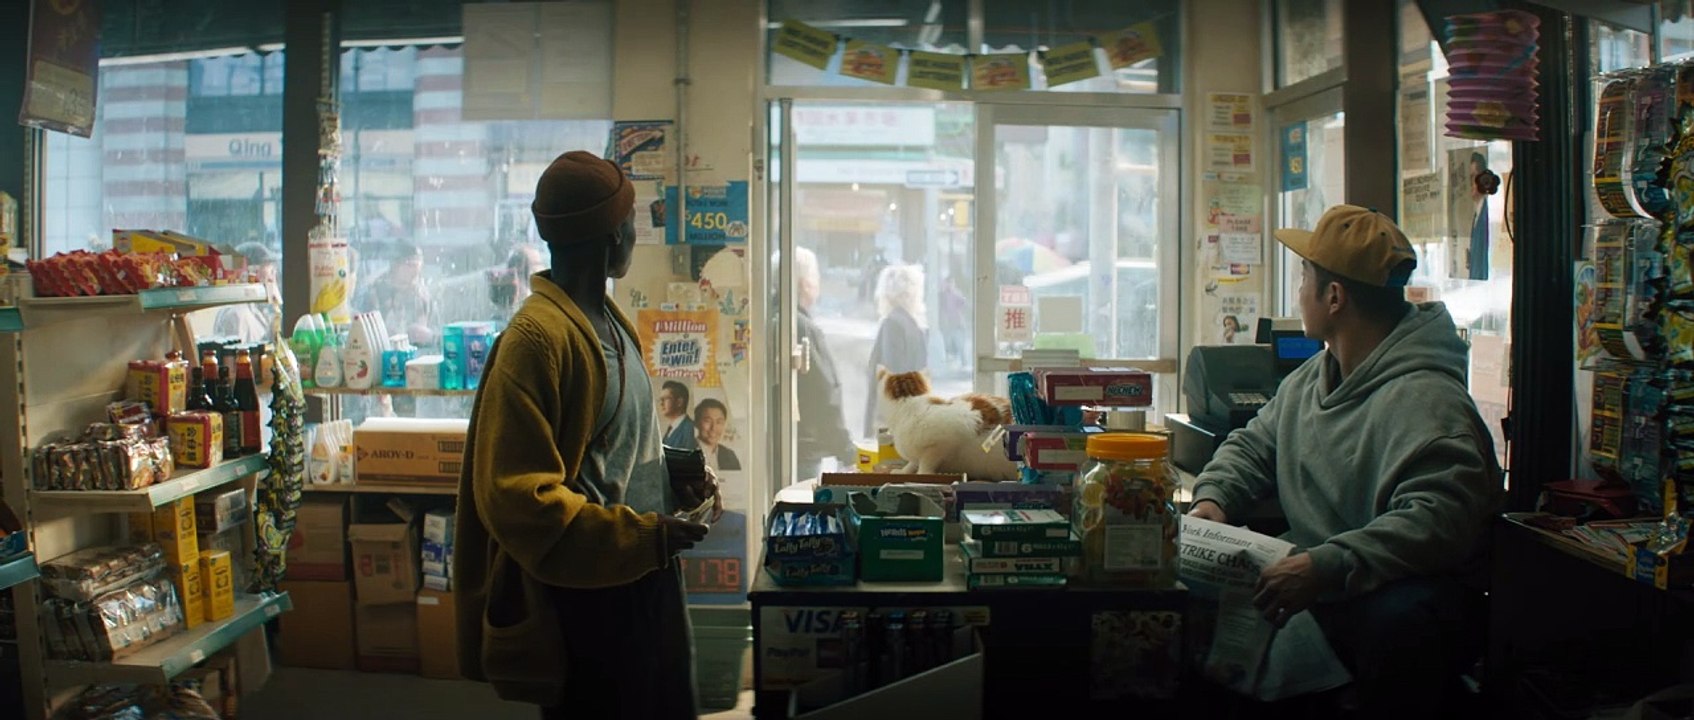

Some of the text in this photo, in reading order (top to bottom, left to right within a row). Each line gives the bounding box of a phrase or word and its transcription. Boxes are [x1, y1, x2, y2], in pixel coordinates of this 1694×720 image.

[1004, 306, 1027, 330] 推
[662, 342, 696, 355] Enter
[371, 449, 415, 459] AROY-D
[1203, 529, 1252, 548] Informant
